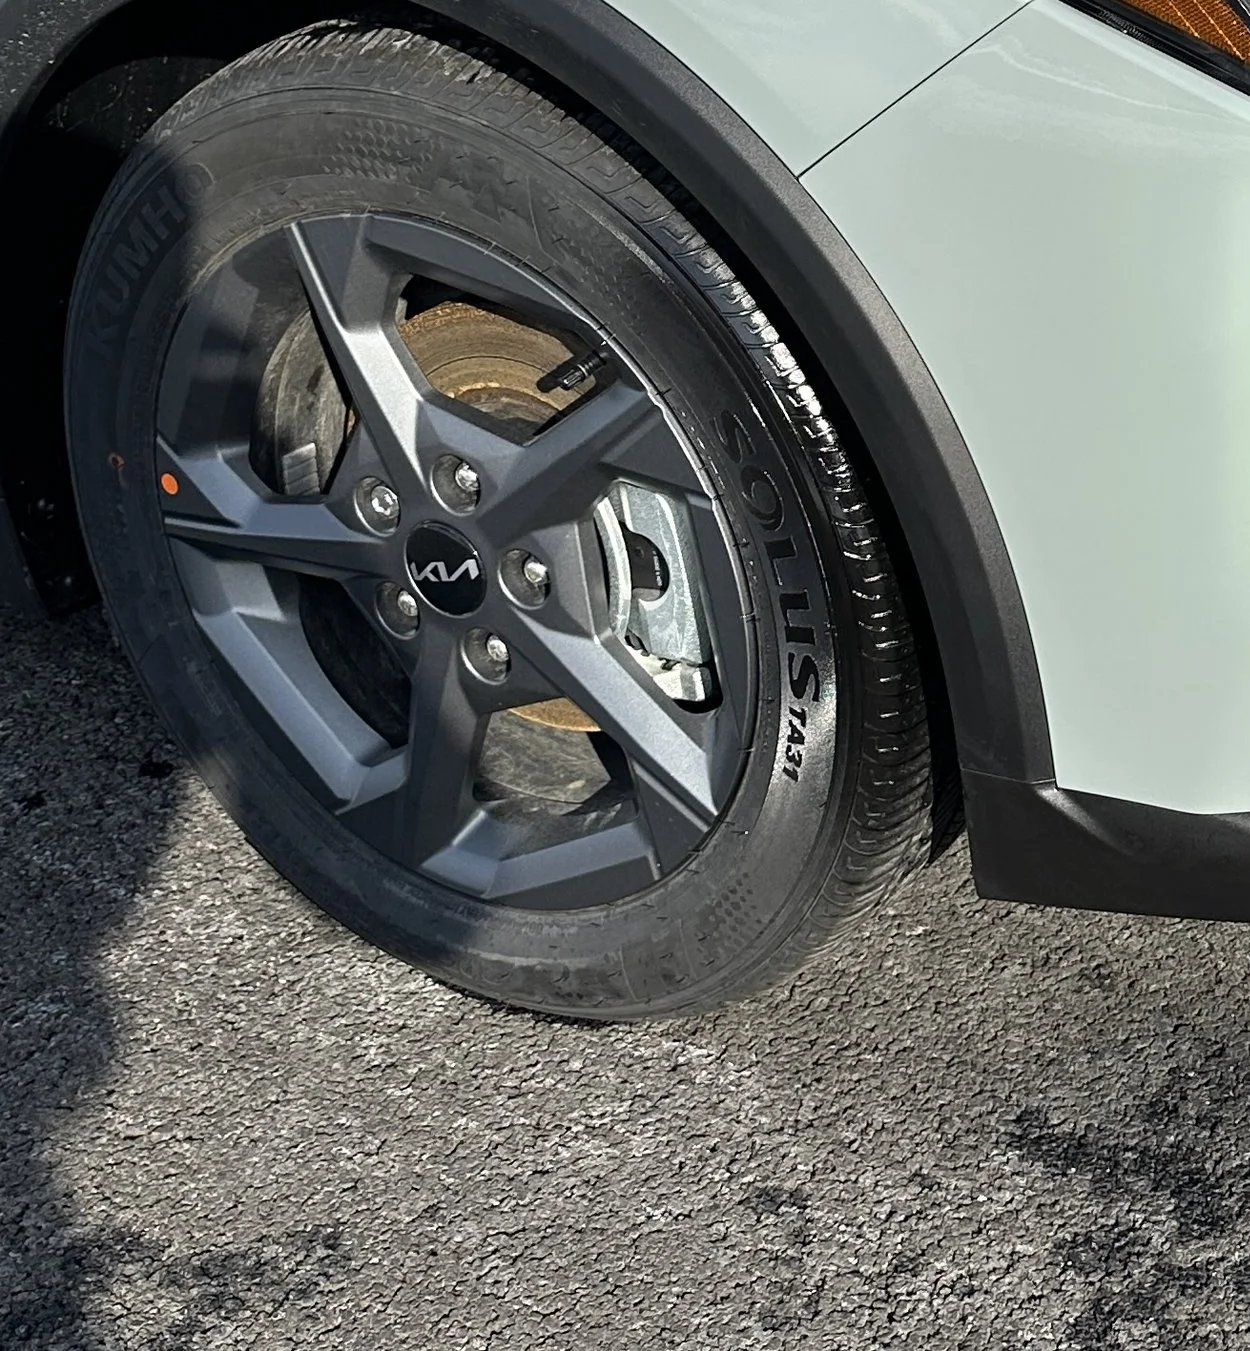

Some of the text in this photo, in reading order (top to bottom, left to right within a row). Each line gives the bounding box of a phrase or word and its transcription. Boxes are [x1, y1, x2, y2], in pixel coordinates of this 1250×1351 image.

[86, 162, 216, 360] KUMHO
[410, 559, 479, 581] KIA
[713, 410, 820, 783] SOLUS TA31
